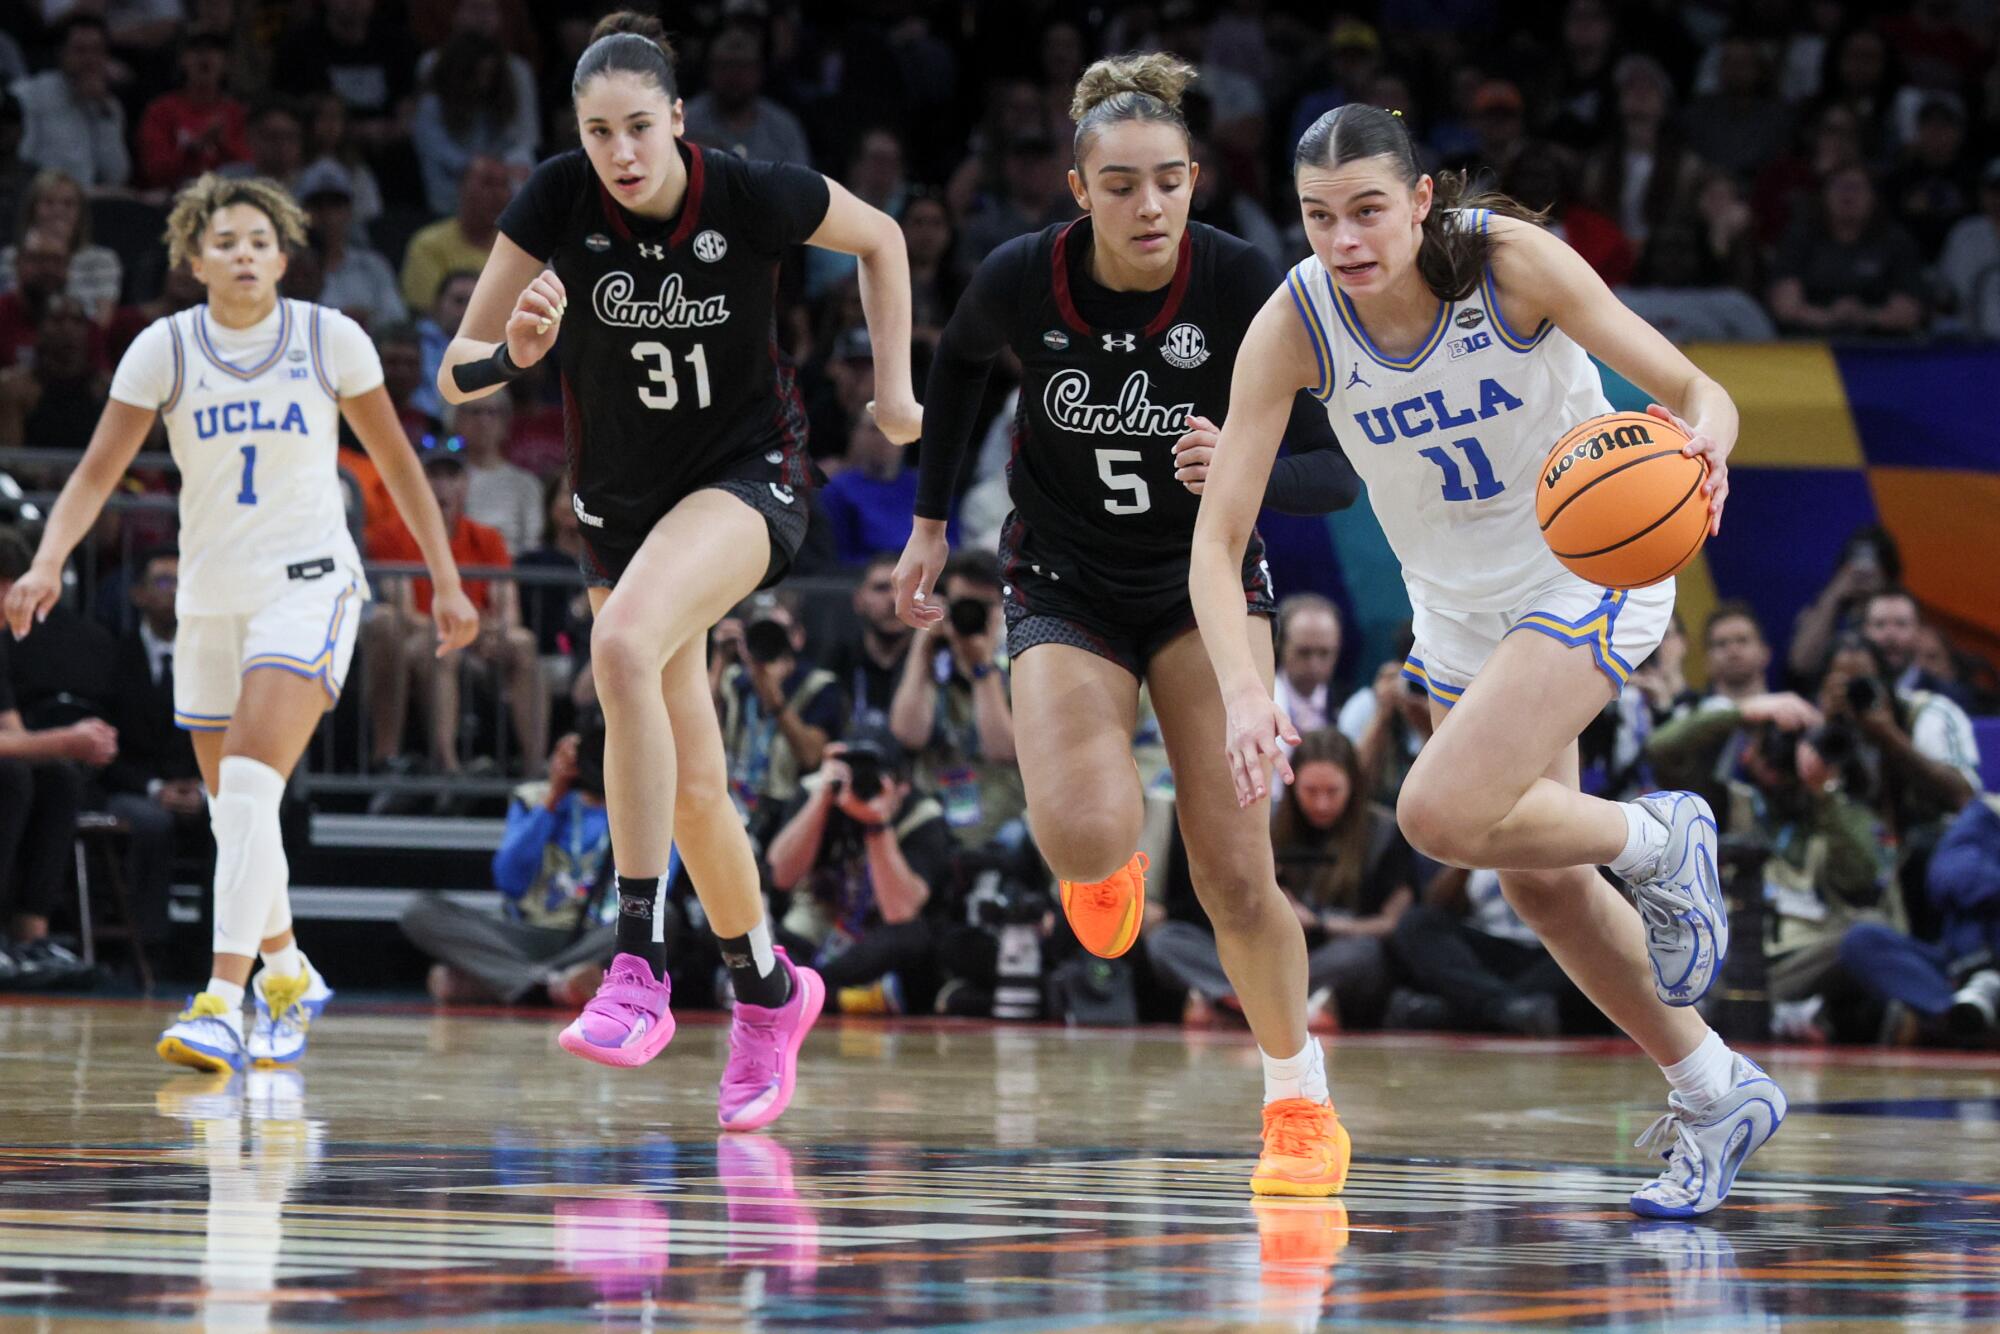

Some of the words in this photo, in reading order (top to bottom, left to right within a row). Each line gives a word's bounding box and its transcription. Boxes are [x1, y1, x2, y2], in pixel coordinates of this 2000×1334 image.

[696, 233, 724, 261] SEC
[593, 271, 731, 329] Carolina
[1164, 352, 1204, 369] GRADUATE
[1169, 326, 1202, 358] SEC
[631, 341, 711, 410] 31
[1043, 368, 1195, 437] Carolina
[194, 400, 308, 440] UCLA
[1353, 378, 1524, 445] UCLA
[237, 444, 257, 505] 1
[1094, 448, 1151, 515] 5
[1418, 437, 1505, 501] 11
[1544, 424, 1655, 490] Wilson
